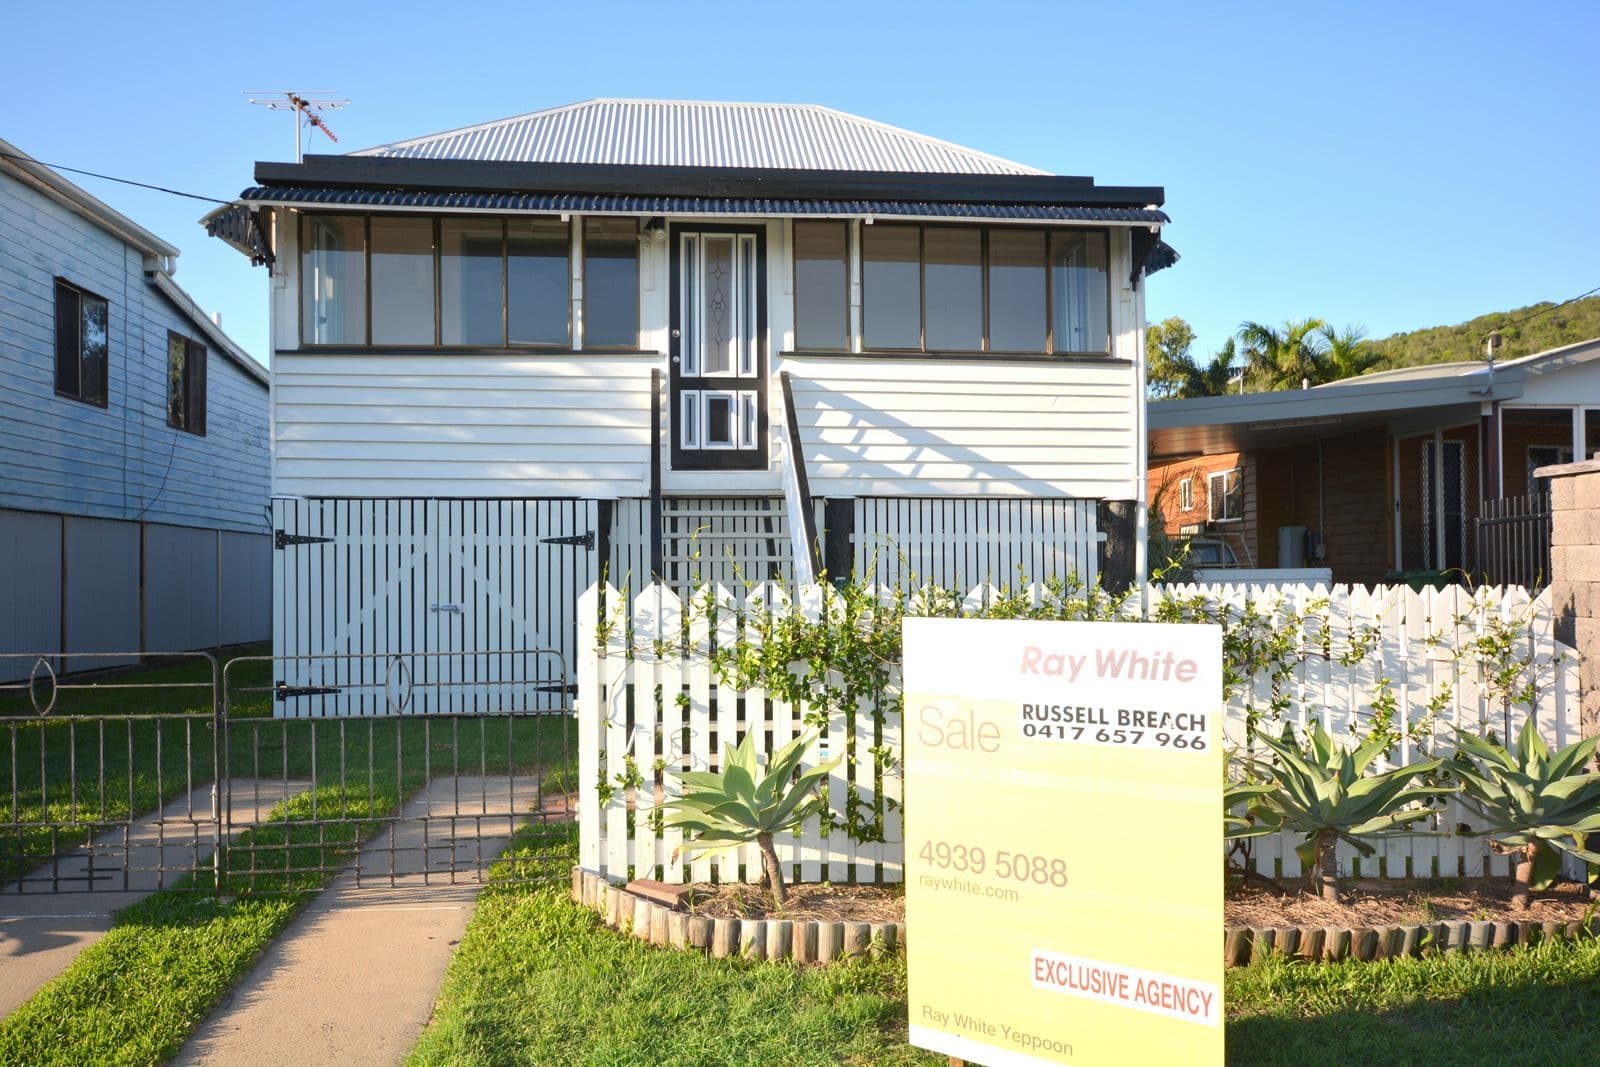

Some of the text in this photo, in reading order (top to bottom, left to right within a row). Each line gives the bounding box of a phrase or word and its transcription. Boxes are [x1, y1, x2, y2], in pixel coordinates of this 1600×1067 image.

[1021, 646, 1198, 683] Ray White
[919, 705, 1000, 752] Sale
[1022, 704, 1206, 732] RUSSELL BREACH
[1023, 723, 1206, 750] 0417 657 966
[919, 840, 1068, 887] 4939 5088
[919, 873, 1019, 902] raywhite.com
[1034, 956, 1213, 1017] EXCLUSIVE AGENCY
[922, 1004, 1073, 1056] Ray White Yeppoon
